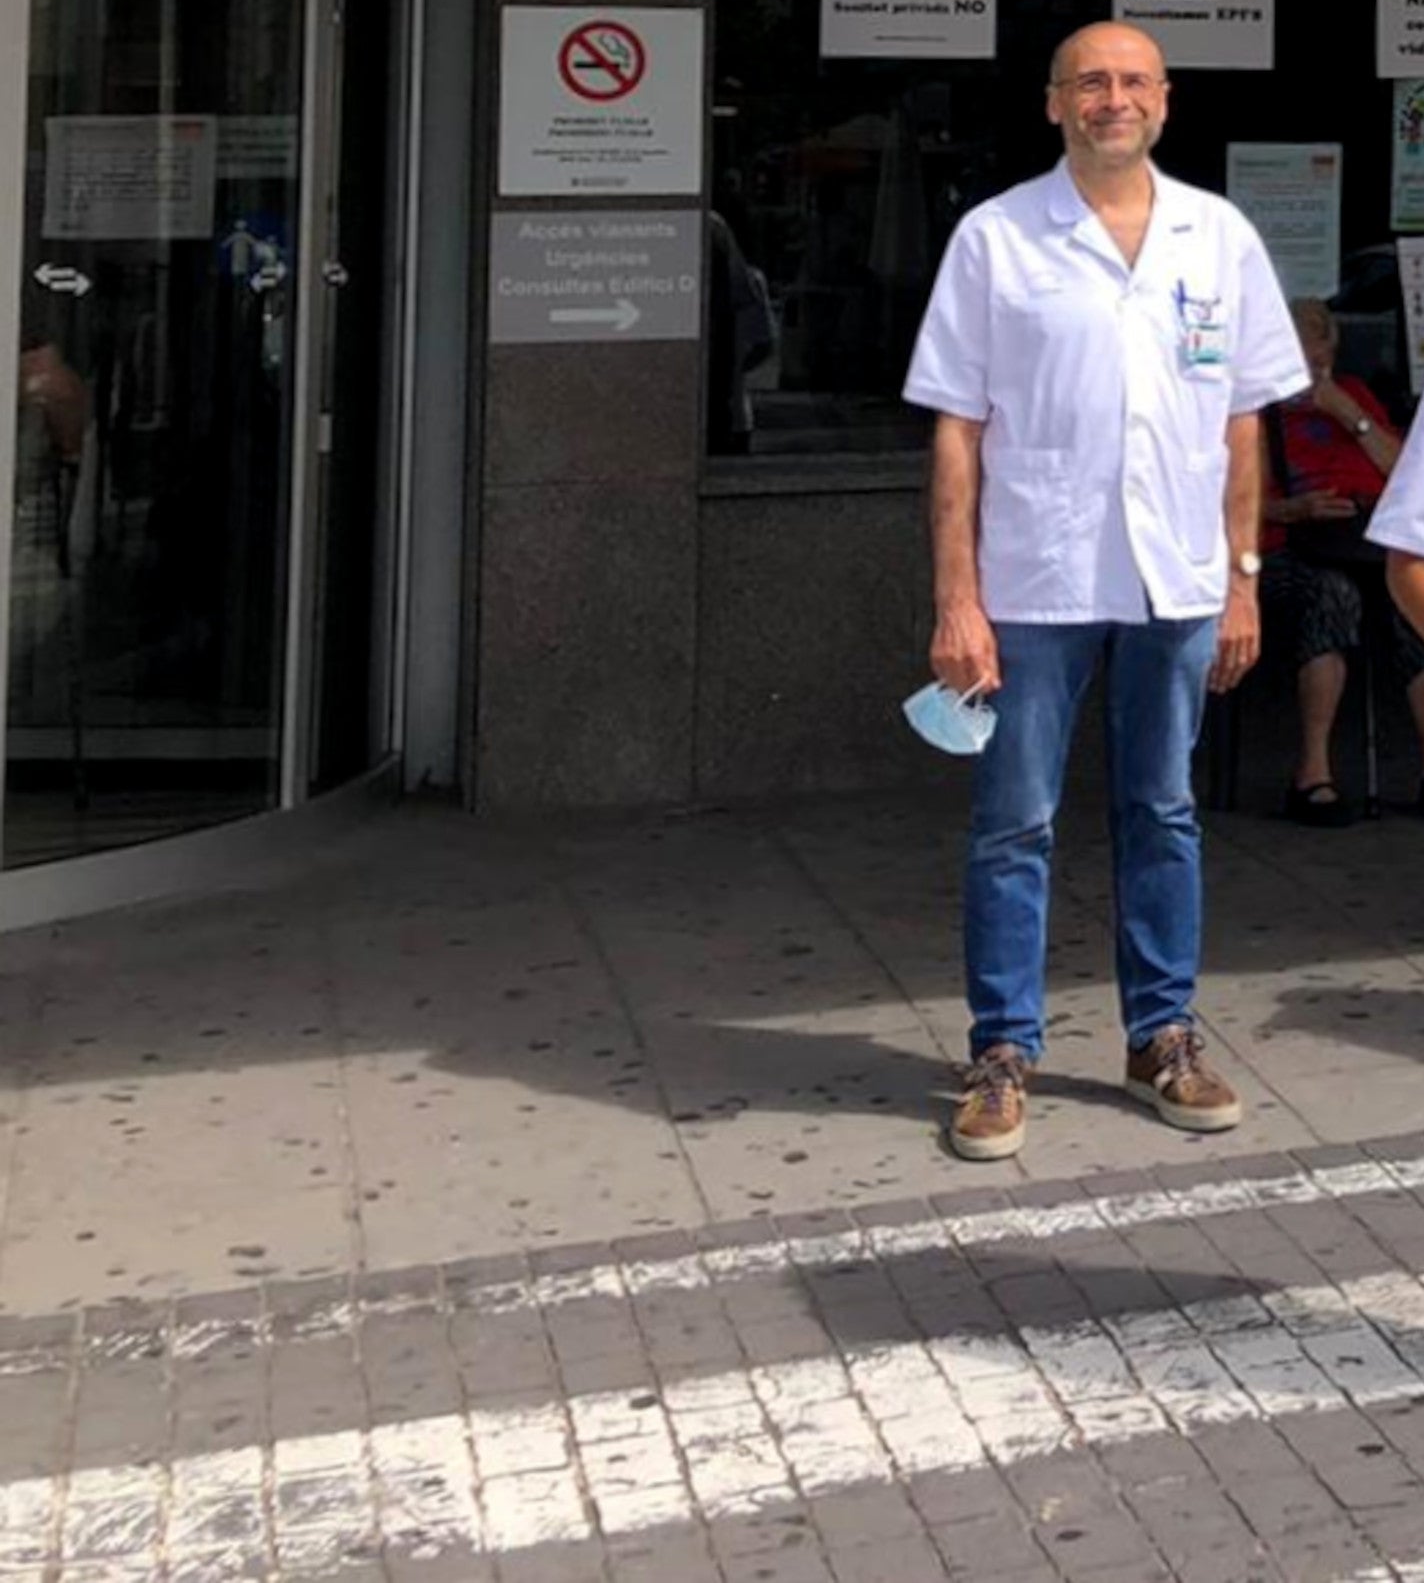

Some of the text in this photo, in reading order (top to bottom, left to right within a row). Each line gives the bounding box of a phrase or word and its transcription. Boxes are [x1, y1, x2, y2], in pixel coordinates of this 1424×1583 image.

[953, 0, 986, 15] NO
[518, 220, 582, 238] Accés
[544, 249, 650, 270] Urgències
[499, 273, 696, 296] Consultes Edifici D
